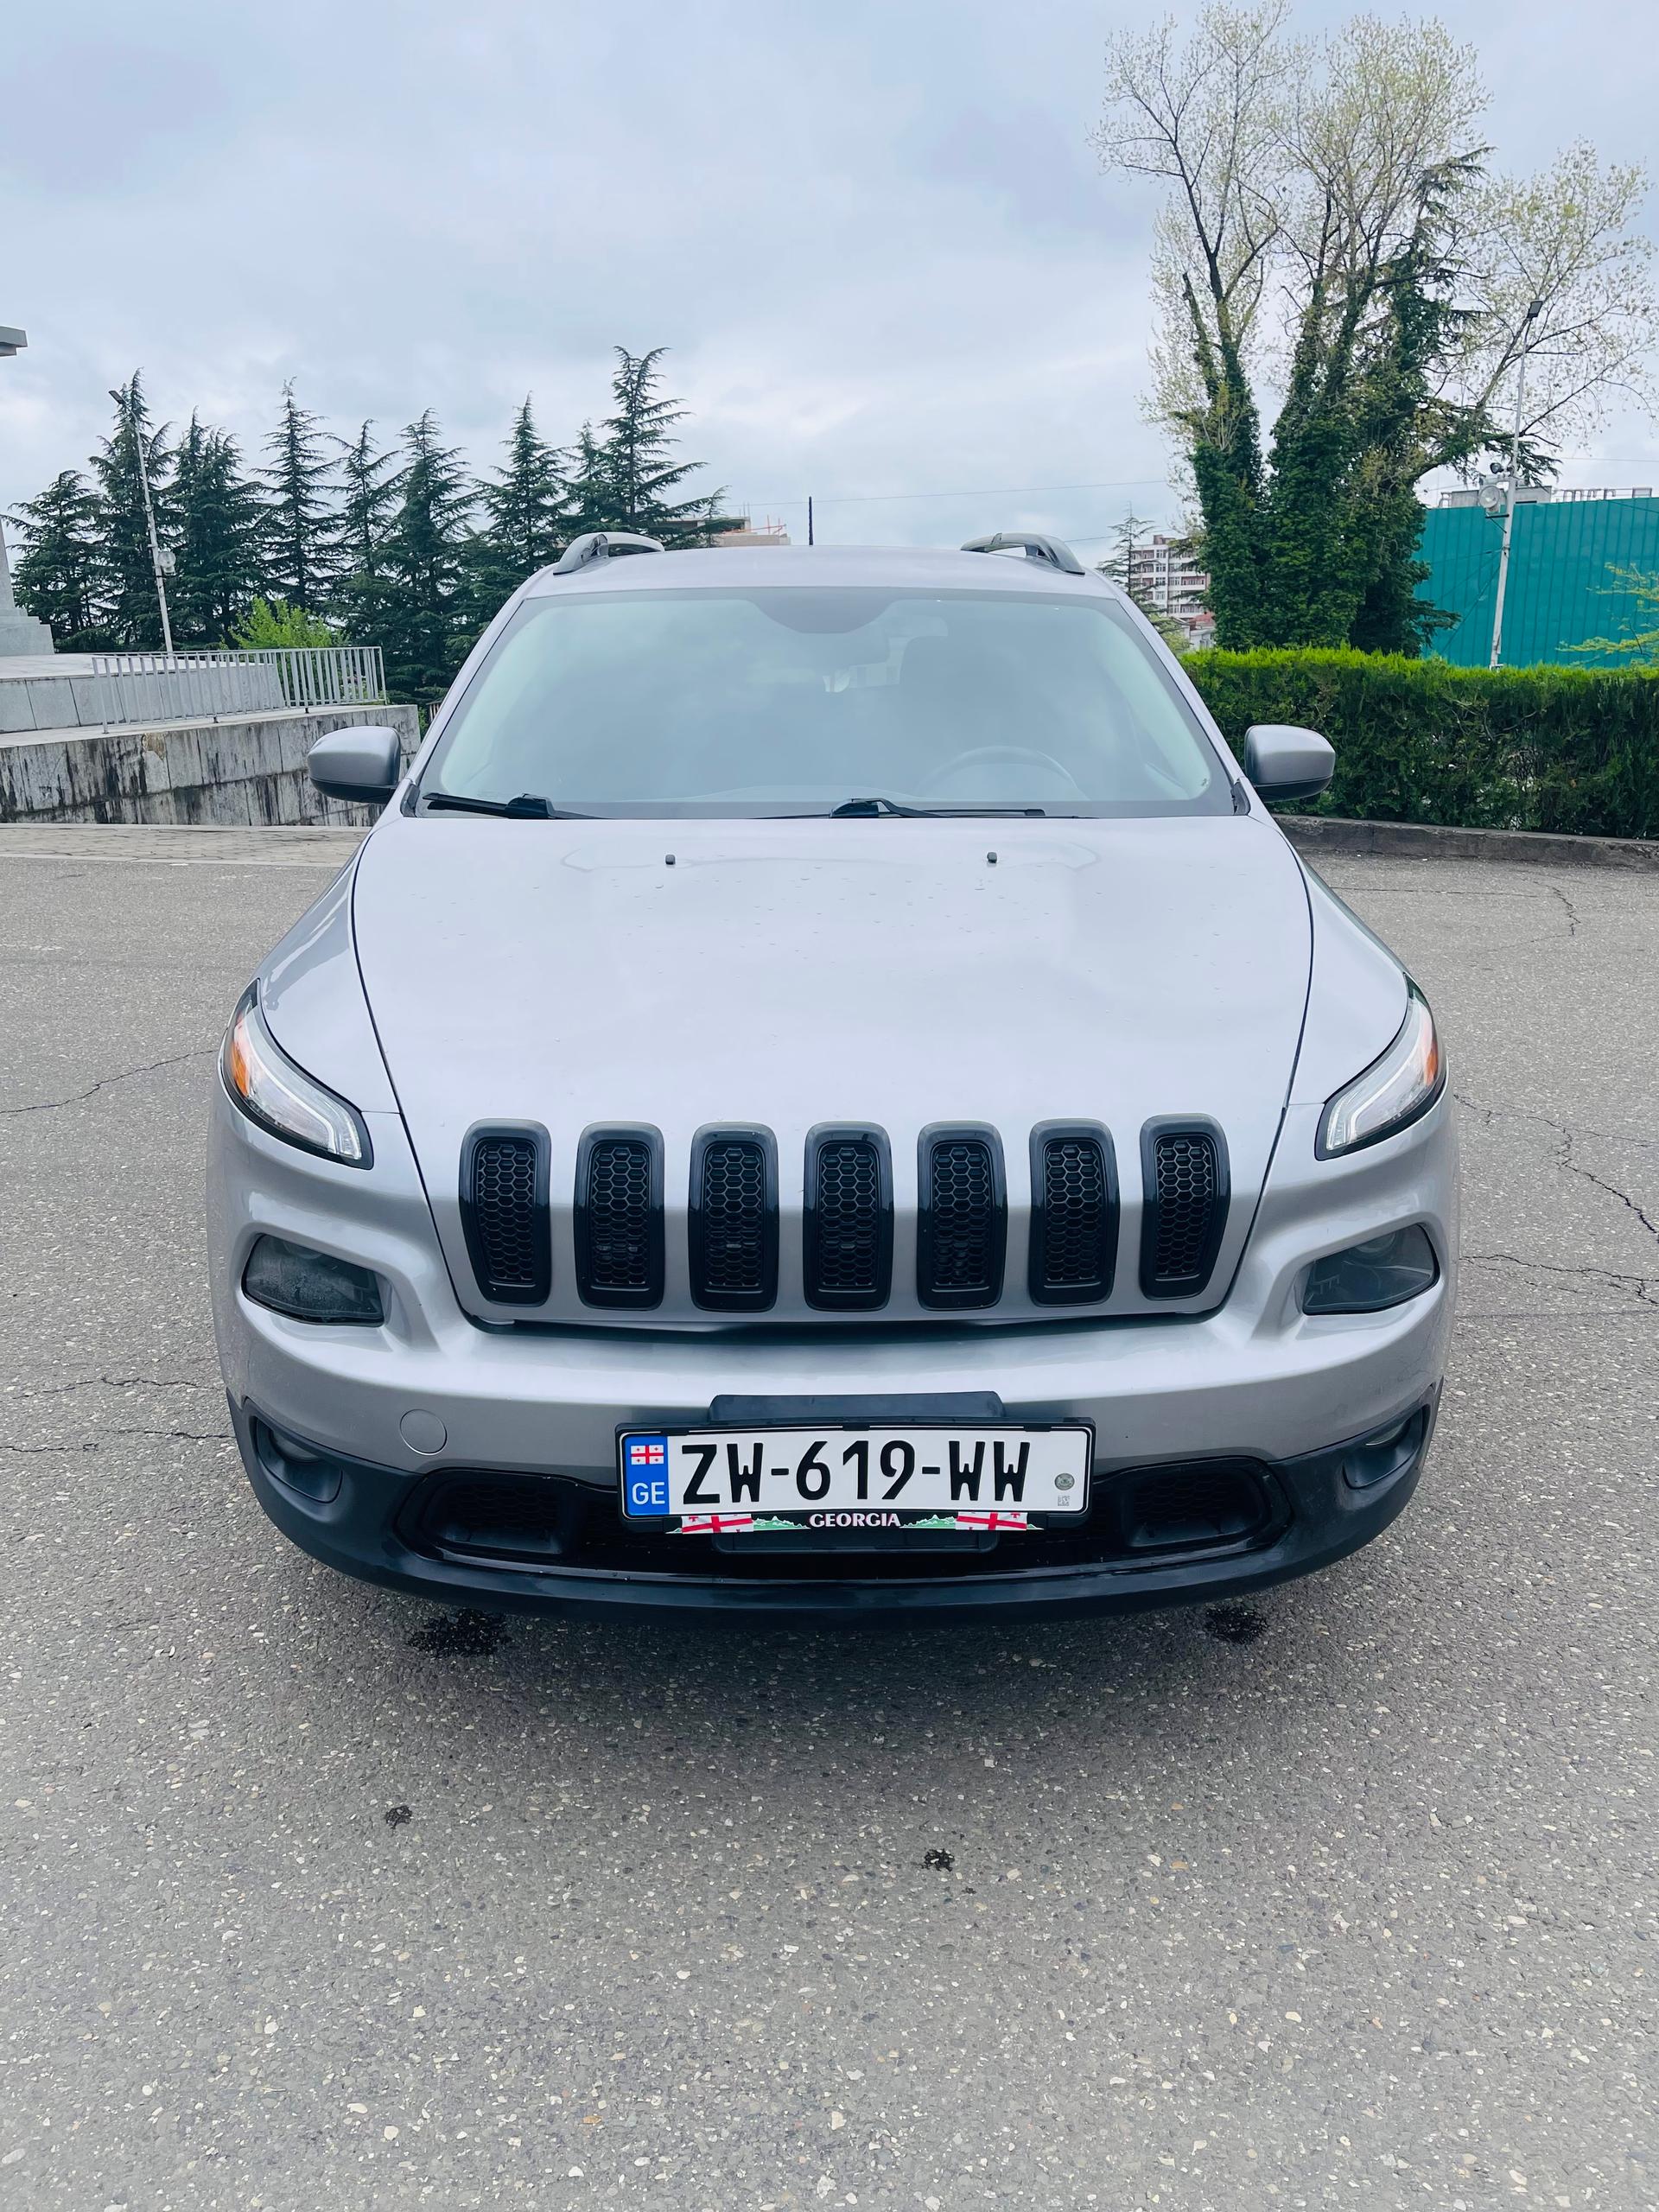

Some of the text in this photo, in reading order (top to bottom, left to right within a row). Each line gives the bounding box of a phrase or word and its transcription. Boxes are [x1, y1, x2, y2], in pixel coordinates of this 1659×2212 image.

[681, 1440, 1031, 1505] ZW-619-WW
[632, 1481, 665, 1505] GE
[809, 1512, 901, 1528] GEORGIA
